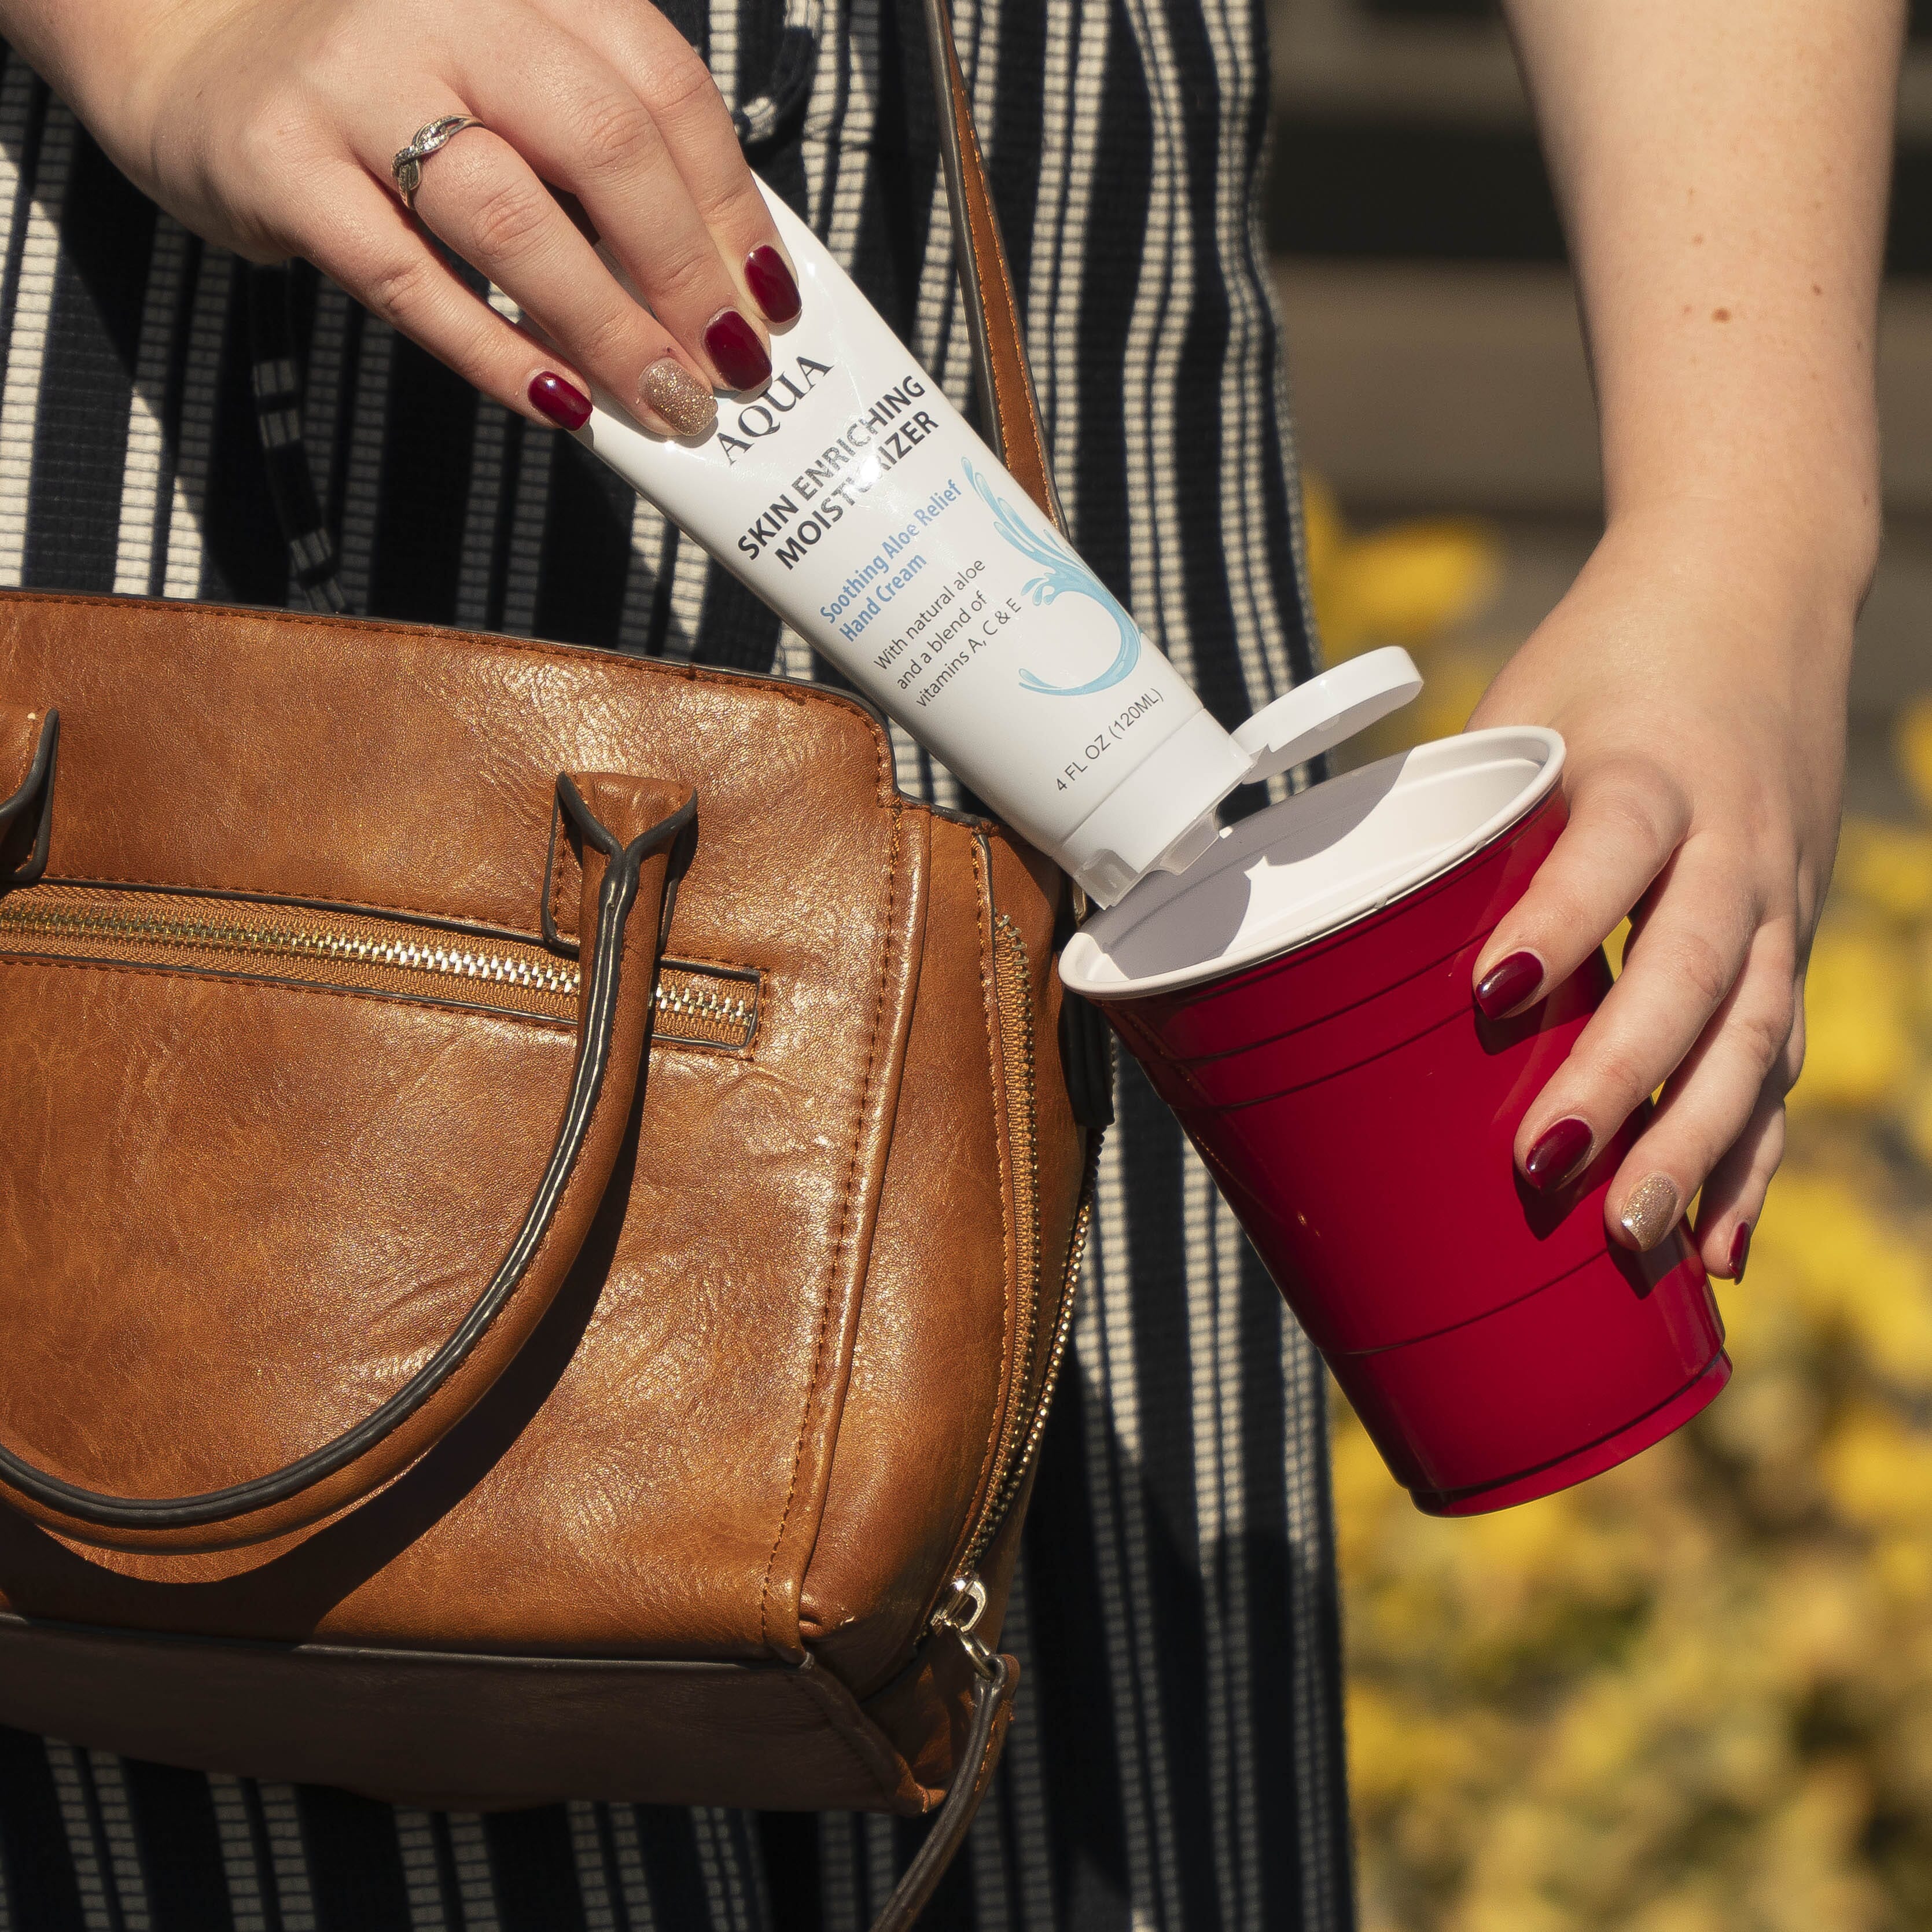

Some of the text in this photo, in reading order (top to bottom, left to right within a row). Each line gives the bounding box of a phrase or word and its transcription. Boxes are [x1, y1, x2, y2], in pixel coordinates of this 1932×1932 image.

[716, 356, 834, 465] AQUA
[738, 376, 926, 560] SKIN ENRICHING
[775, 411, 939, 570] MOISTIZER
[820, 479, 962, 624] Soothing Aloe Relief
[839, 554, 927, 642] Hand Cream
[874, 560, 985, 671] With natural aloe
[897, 590, 987, 690] and a blend of
[917, 598, 1022, 708] vitamins A, C & E
[1056, 687, 1164, 791] 4 FL OZ (120ML)
